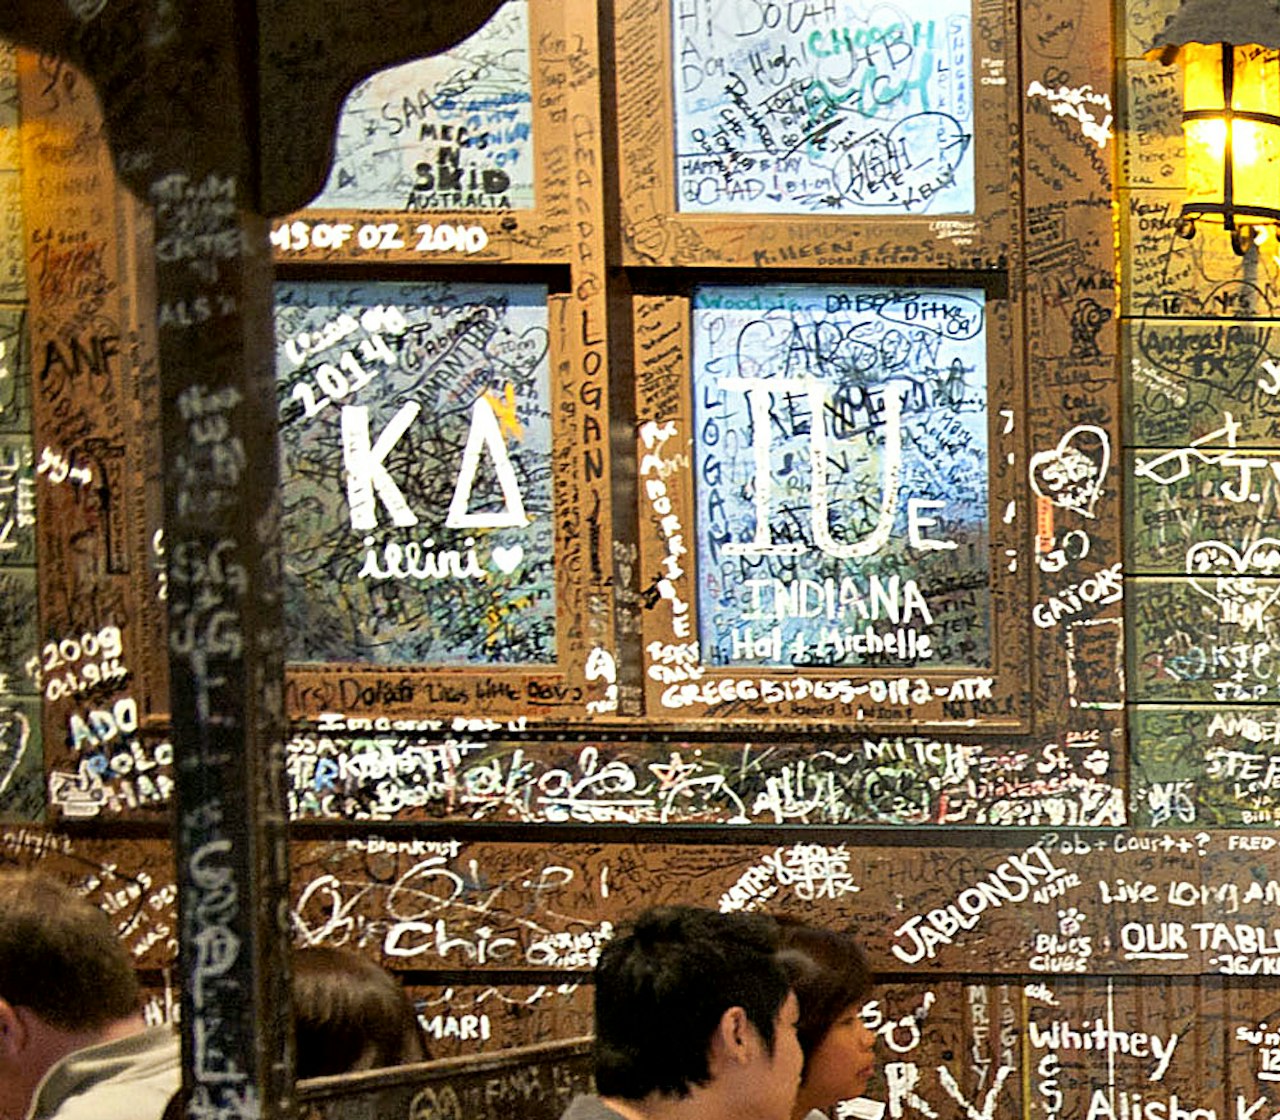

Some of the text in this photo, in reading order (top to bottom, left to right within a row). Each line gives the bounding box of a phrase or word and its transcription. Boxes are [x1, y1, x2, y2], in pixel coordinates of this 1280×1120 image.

[416, 223, 489, 254] 2010
[292, 333, 397, 418] 2014
[357, 536, 486, 579] illini
[739, 576, 934, 625] INDIANA
[43, 625, 123, 671] 2009
[731, 628, 782, 661] Hal
[814, 626, 934, 661] Michelle
[891, 845, 1071, 965] JABLONSKI
[1120, 920, 1190, 953] OUR
[417, 1013, 491, 1042] MARI
[1028, 1018, 1179, 1081] Whitney
